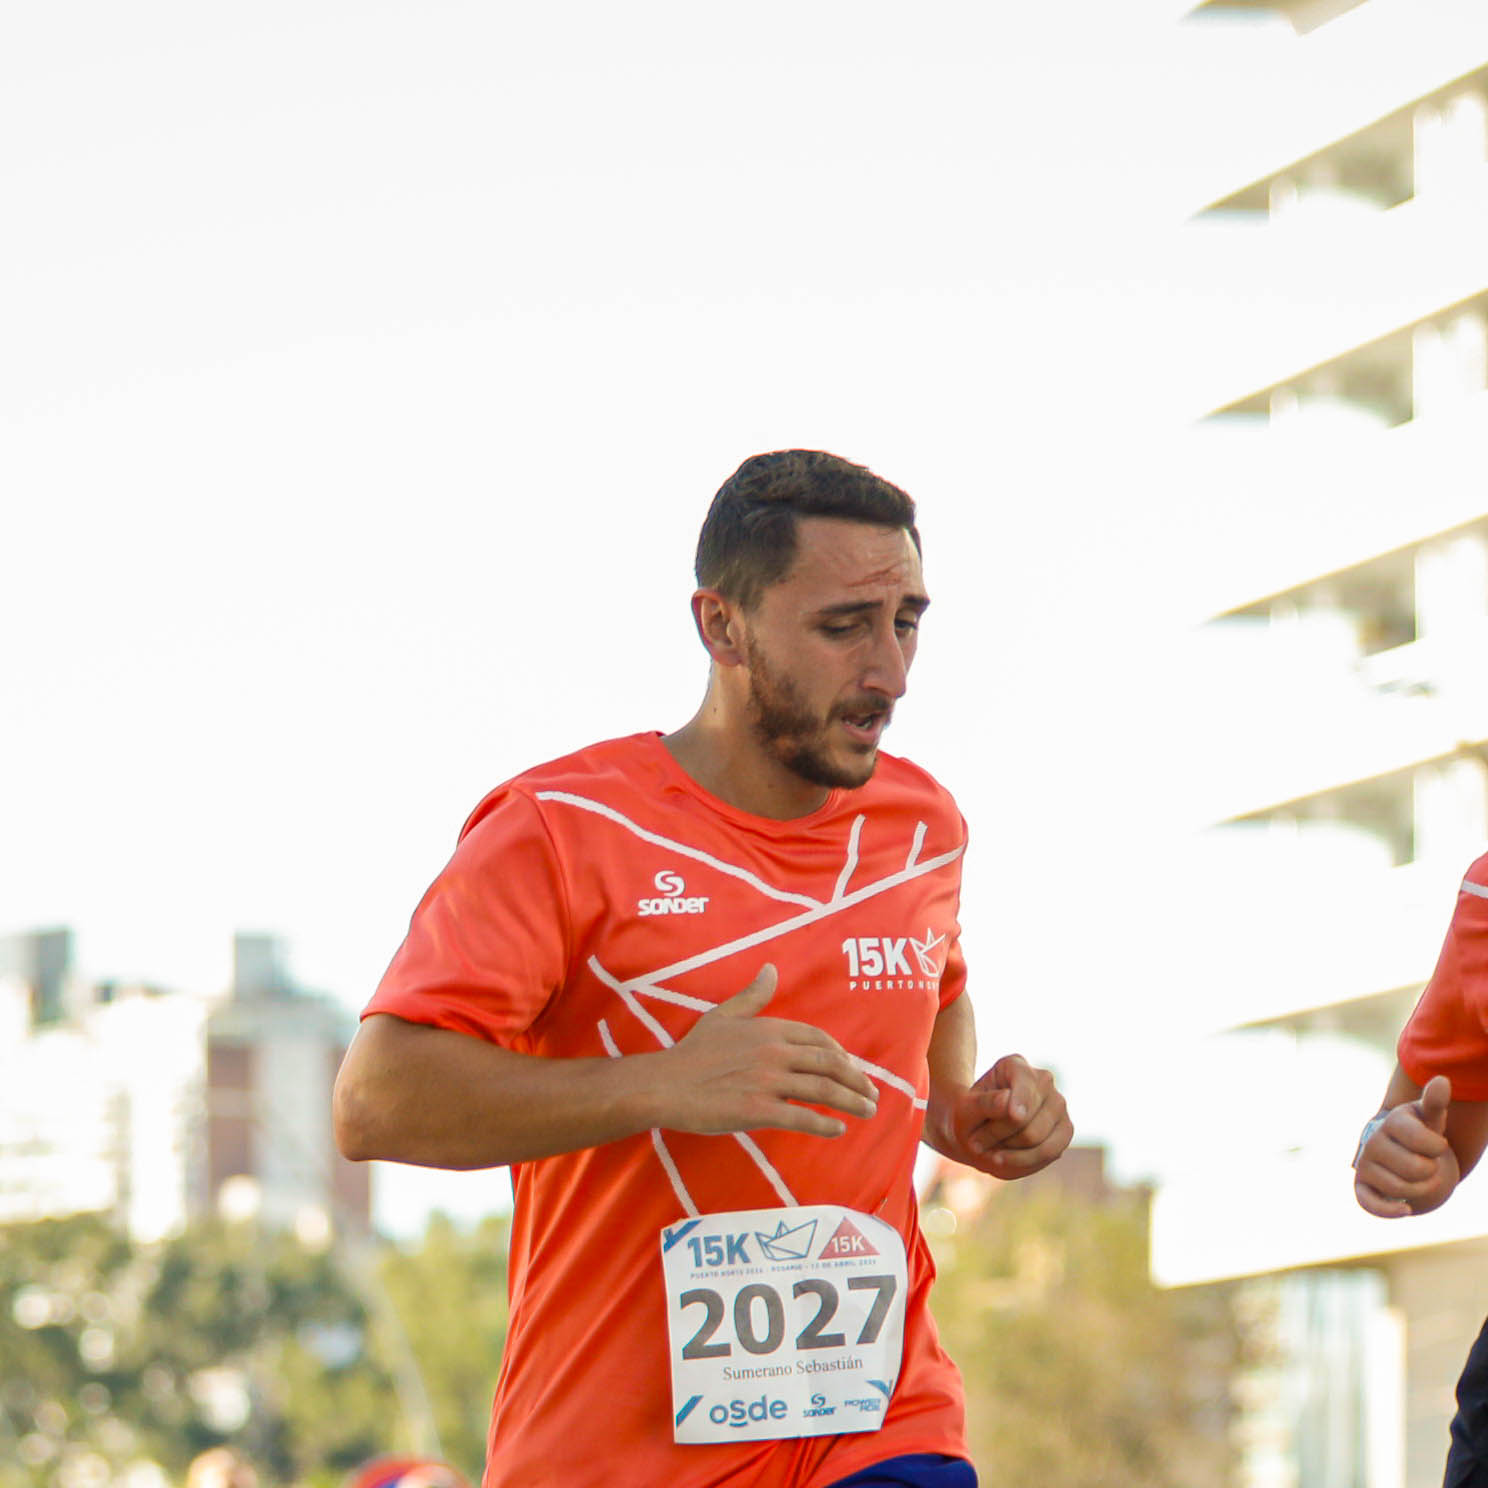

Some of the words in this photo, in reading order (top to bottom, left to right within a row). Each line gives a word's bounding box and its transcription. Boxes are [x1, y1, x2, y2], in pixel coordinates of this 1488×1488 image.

[841, 936, 913, 977] 15K
[849, 980, 914, 991] PUERTO
[687, 1231, 752, 1268] 15K
[832, 1235, 865, 1253] 15K
[679, 1274, 898, 1361] 2027
[722, 1364, 793, 1380] Sumerano
[796, 1357, 863, 1375] Sebastián
[709, 1394, 788, 1427] osde
